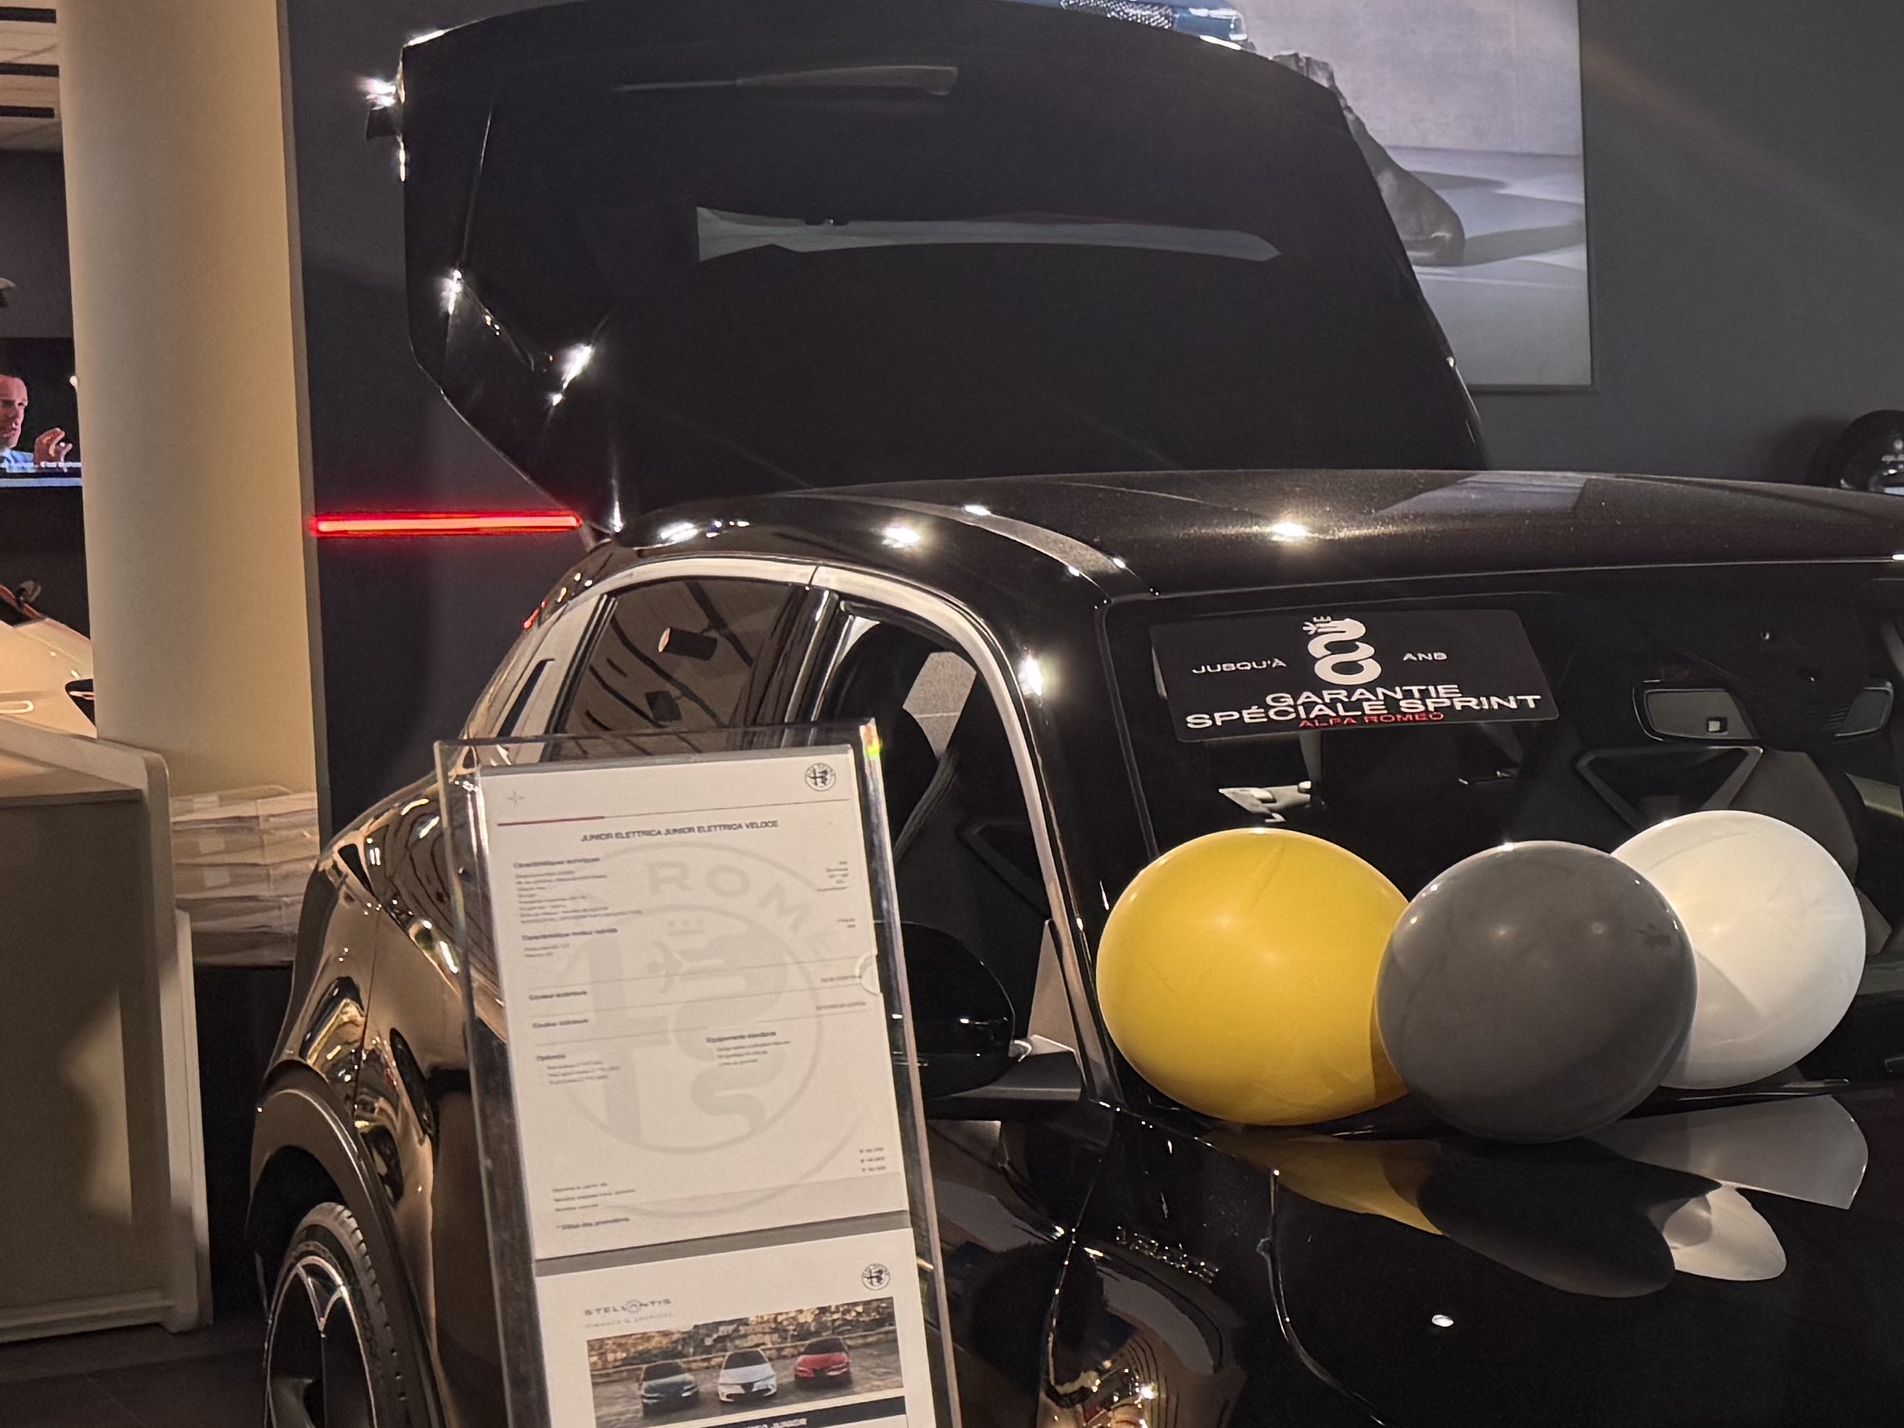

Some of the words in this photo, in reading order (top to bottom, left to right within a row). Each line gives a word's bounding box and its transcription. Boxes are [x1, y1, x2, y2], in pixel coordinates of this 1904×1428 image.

[1265, 684, 1463, 708] GARANTIE
[1185, 695, 1386, 730] SPÉCIALE
[1398, 694, 1543, 715] SPRINT
[1299, 715, 1358, 729] ALFA
[1363, 711, 1446, 724] ROMEO
[745, 819, 779, 830] VELOCE
